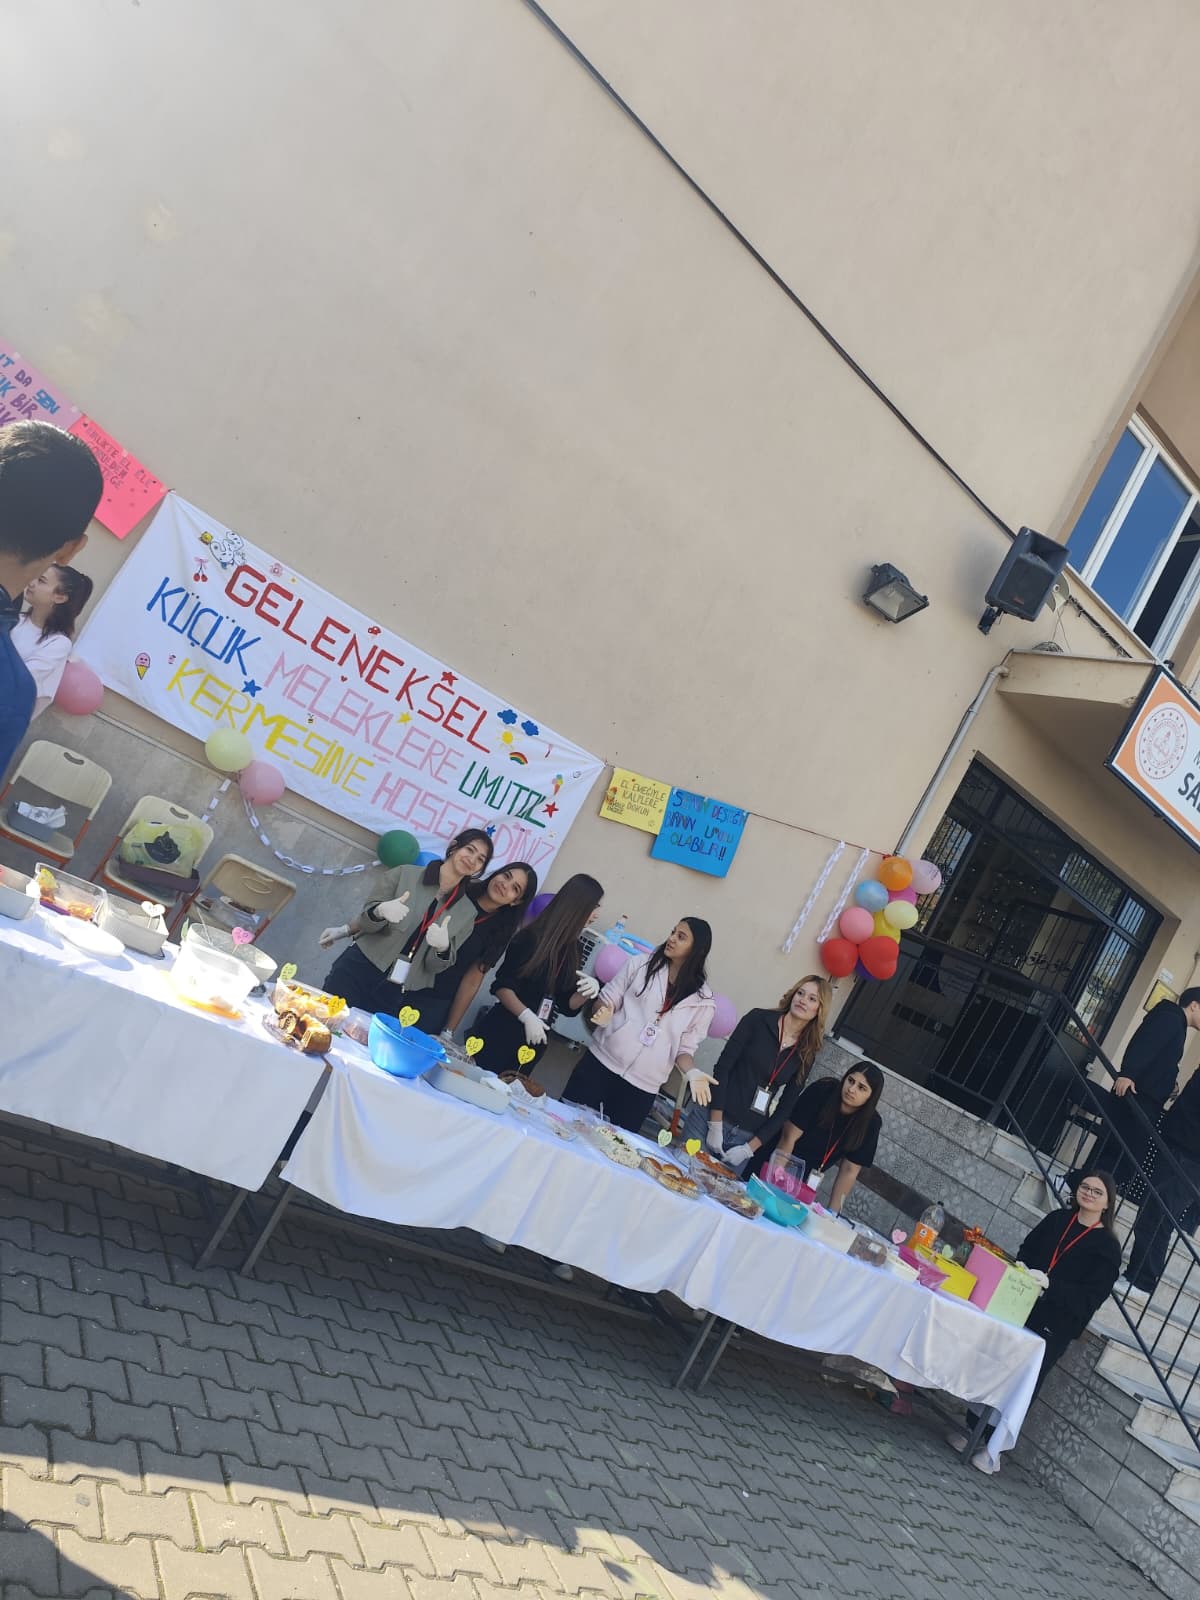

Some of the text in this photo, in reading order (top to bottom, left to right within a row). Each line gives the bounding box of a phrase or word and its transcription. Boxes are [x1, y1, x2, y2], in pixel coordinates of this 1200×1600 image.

[15, 369, 32, 387] DA
[146, 577, 261, 676] KÜÇÜK
[263, 651, 465, 785] MELEKLERE
[165, 658, 375, 797] KERMESİNE
[225, 564, 491, 754] GELENEKSEL
